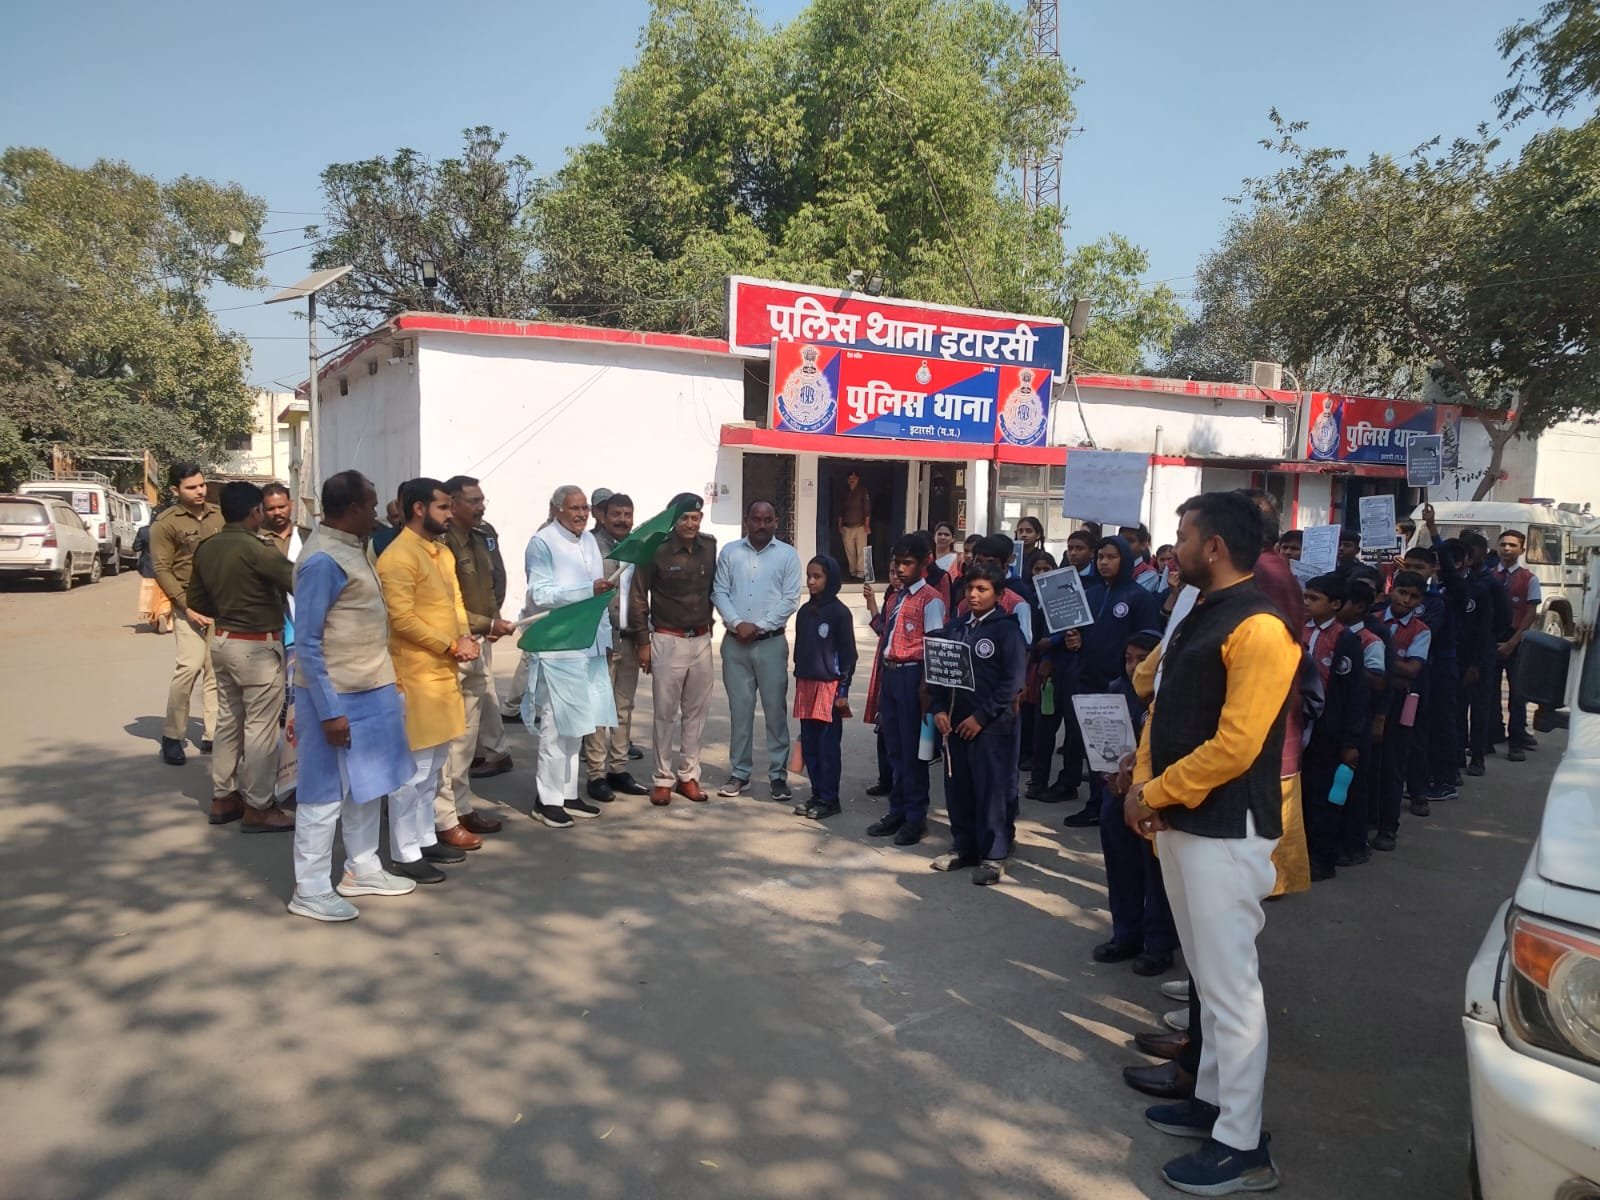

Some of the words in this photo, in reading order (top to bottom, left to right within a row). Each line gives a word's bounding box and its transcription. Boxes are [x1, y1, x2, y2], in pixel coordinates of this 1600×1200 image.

[867, 311, 937, 351] थाना
[940, 323, 1039, 361] इटारसी
[846, 379, 928, 424] पुलिस
[933, 393, 993, 423] थाना
[909, 424, 935, 436] इटारसी
[937, 426, 961, 438] (म.प्र.)
[1346, 420, 1391, 452] पुलिस
